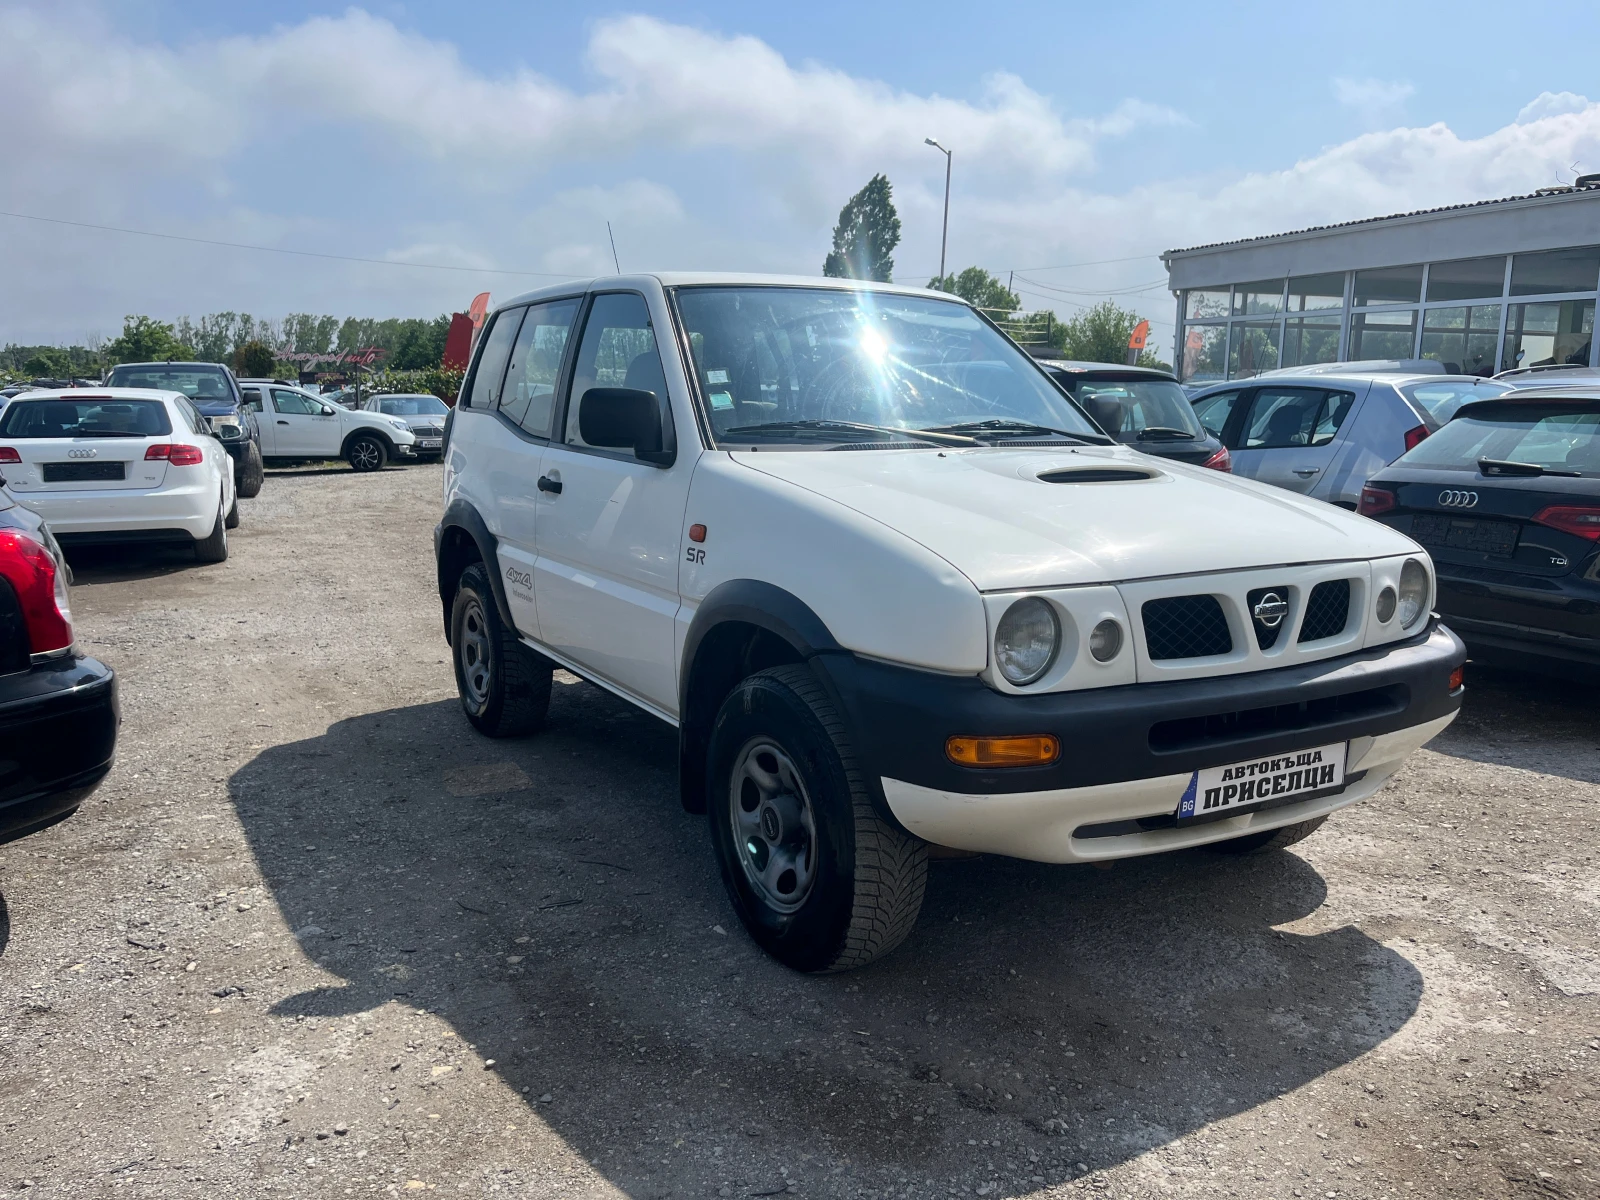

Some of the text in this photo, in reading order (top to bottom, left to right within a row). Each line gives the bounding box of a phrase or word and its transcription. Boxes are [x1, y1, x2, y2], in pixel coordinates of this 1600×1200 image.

[686, 547, 706, 565] SR
[1549, 556, 1568, 565] TDI
[1221, 750, 1323, 782] АВТОКЪЩА
[1203, 763, 1336, 810] ПРИСЕЛЦИ
[1182, 799, 1194, 812] BG
